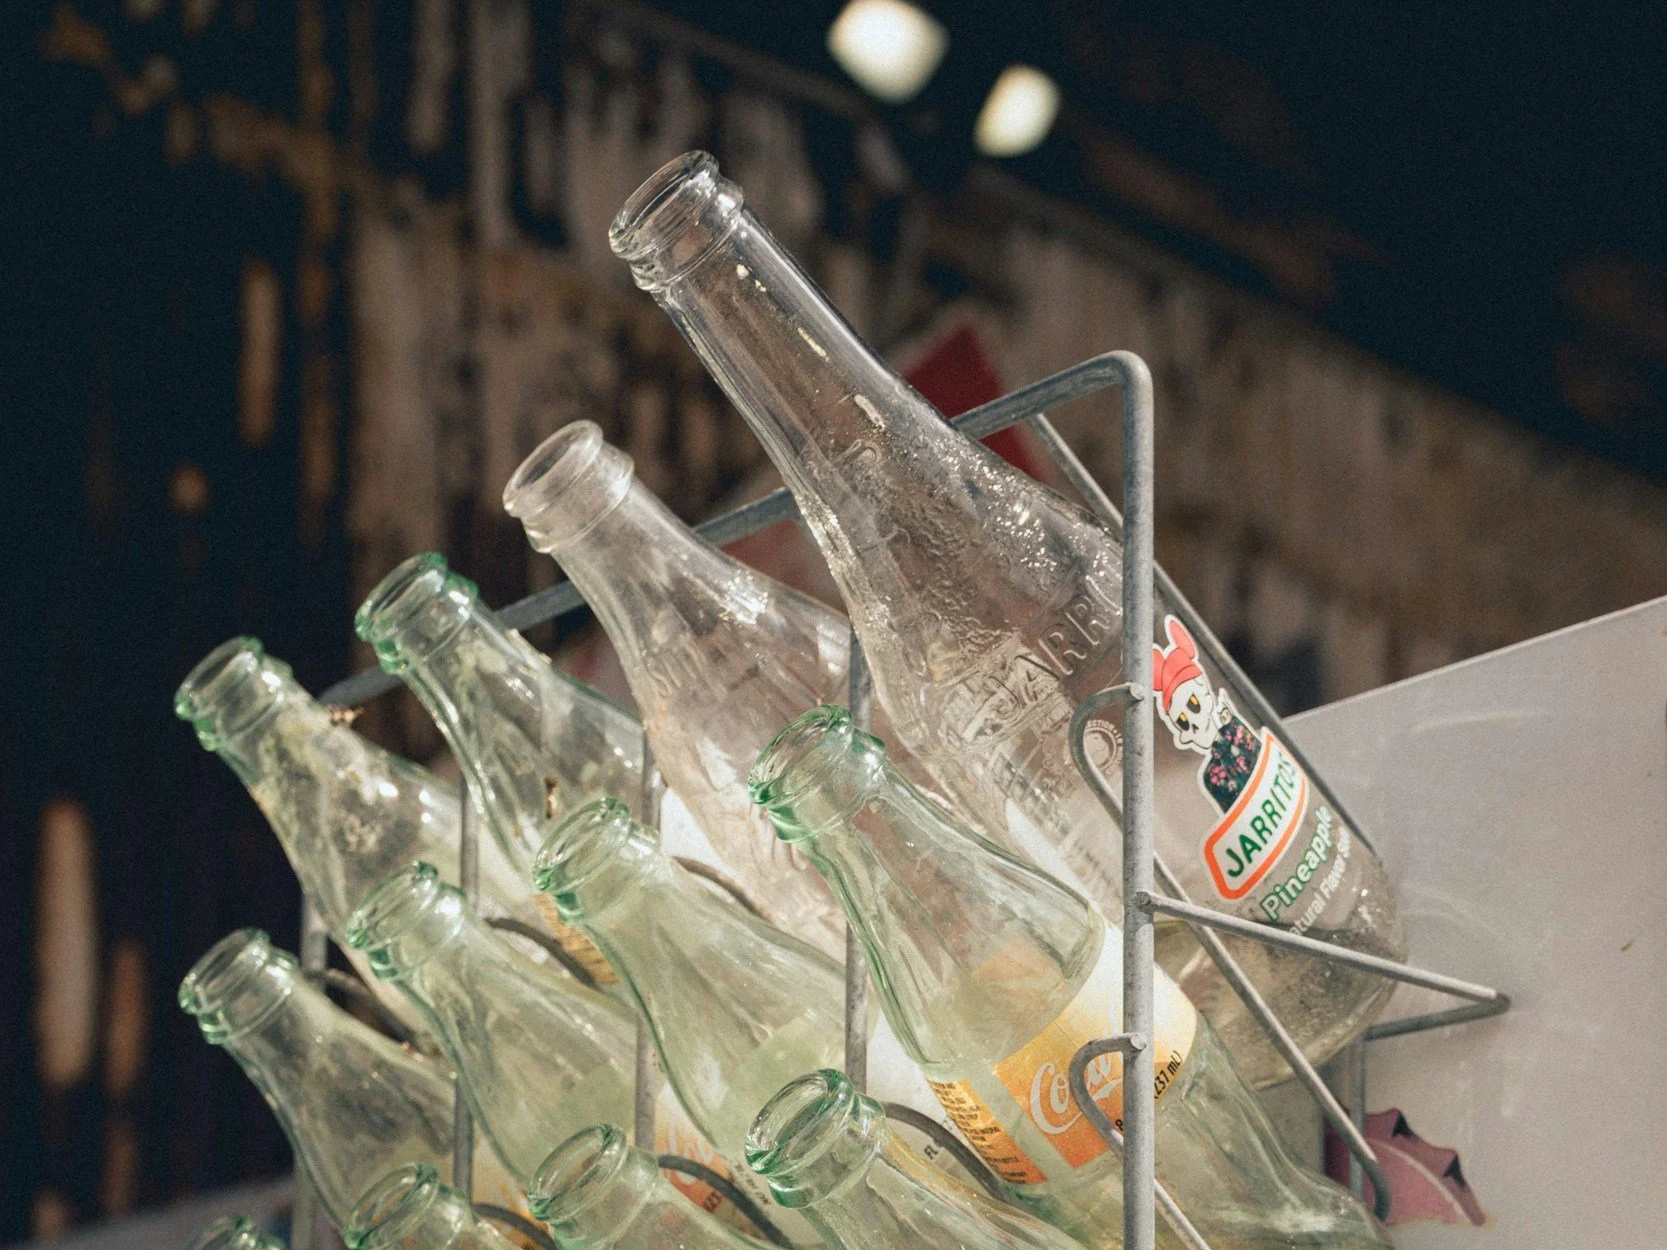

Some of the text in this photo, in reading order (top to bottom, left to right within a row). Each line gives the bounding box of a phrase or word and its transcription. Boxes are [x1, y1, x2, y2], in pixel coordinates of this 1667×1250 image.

[1226, 752, 1296, 878] JARRITOS
[1260, 805, 1332, 922] Pineapple
[1289, 892, 1326, 936] atural
